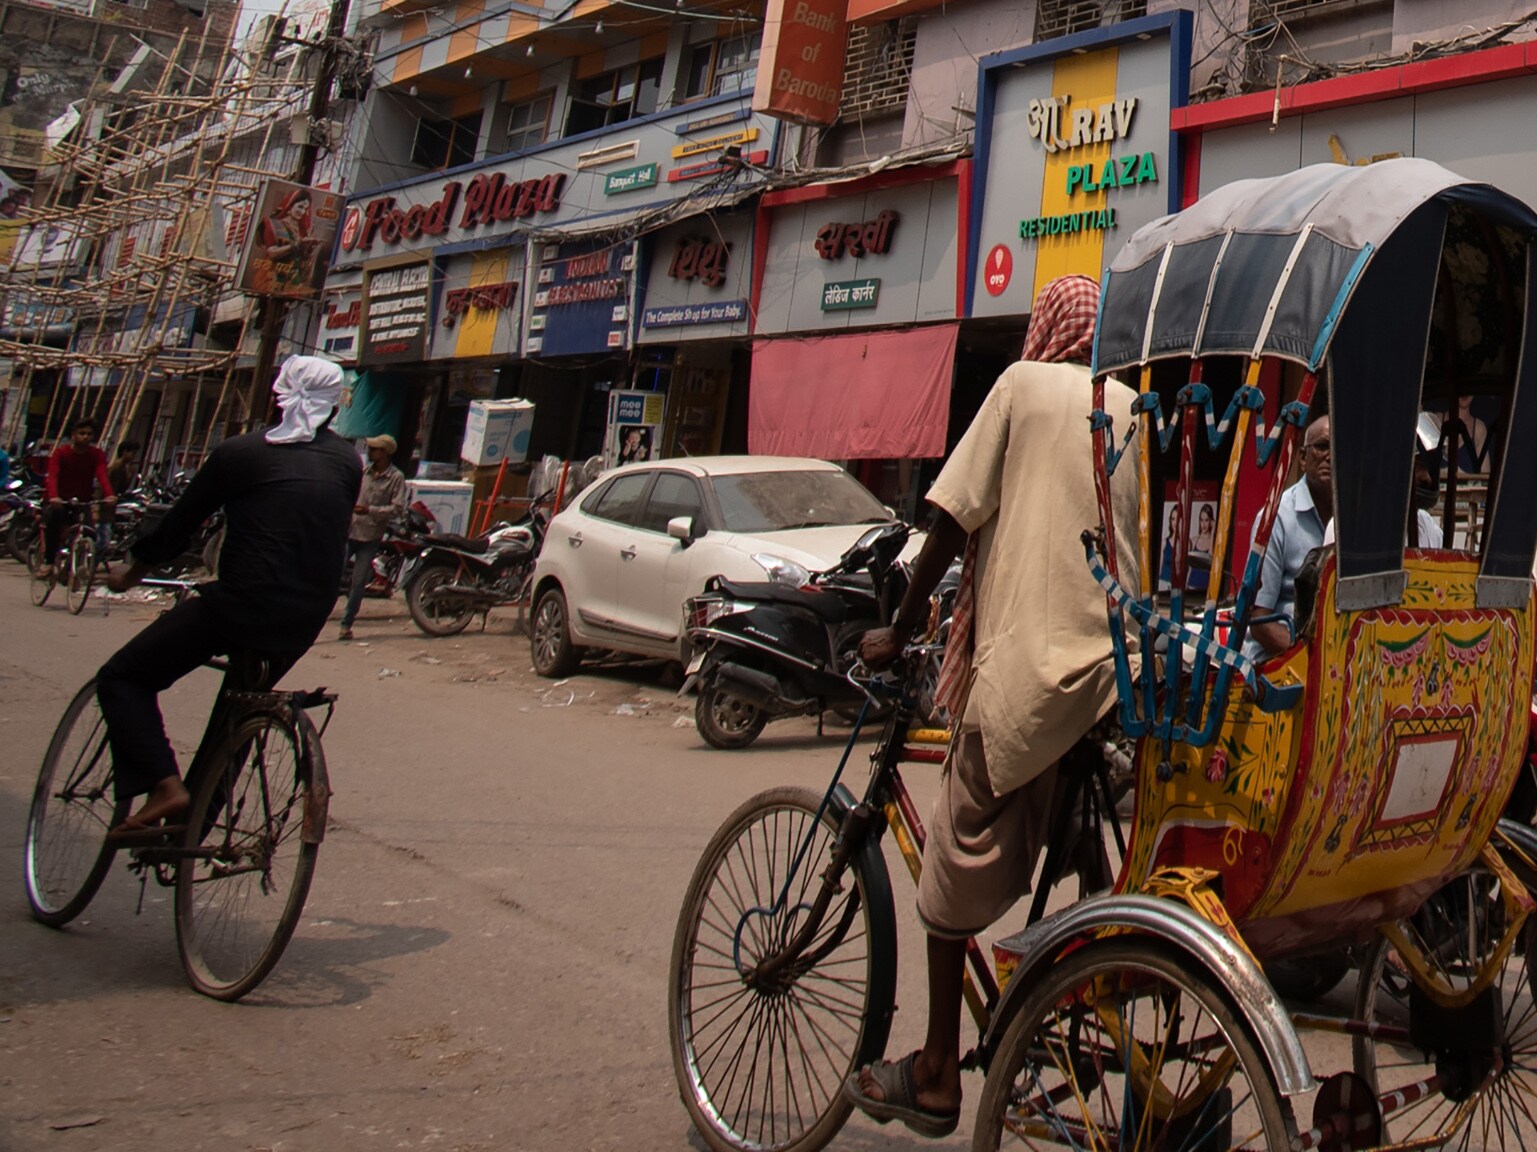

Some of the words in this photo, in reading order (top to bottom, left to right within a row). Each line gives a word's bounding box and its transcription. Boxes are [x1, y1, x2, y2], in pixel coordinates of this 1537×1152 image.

[793, 1, 837, 34] Bank
[802, 43, 822, 64] of
[775, 68, 837, 104] Baroda
[1067, 97, 1138, 148] RAV
[609, 172, 635, 189] Banquet
[638, 167, 651, 182] Hall
[1066, 152, 1157, 195] PLAZA
[357, 182, 462, 250] Food
[459, 172, 567, 229] Plaza
[1018, 208, 1118, 239] RESIDENTIAL
[990, 273, 1005, 285] OYO
[646, 311, 656, 323] The
[657, 309, 683, 323] Complete
[700, 307, 710, 320] for
[711, 306, 724, 318] Your
